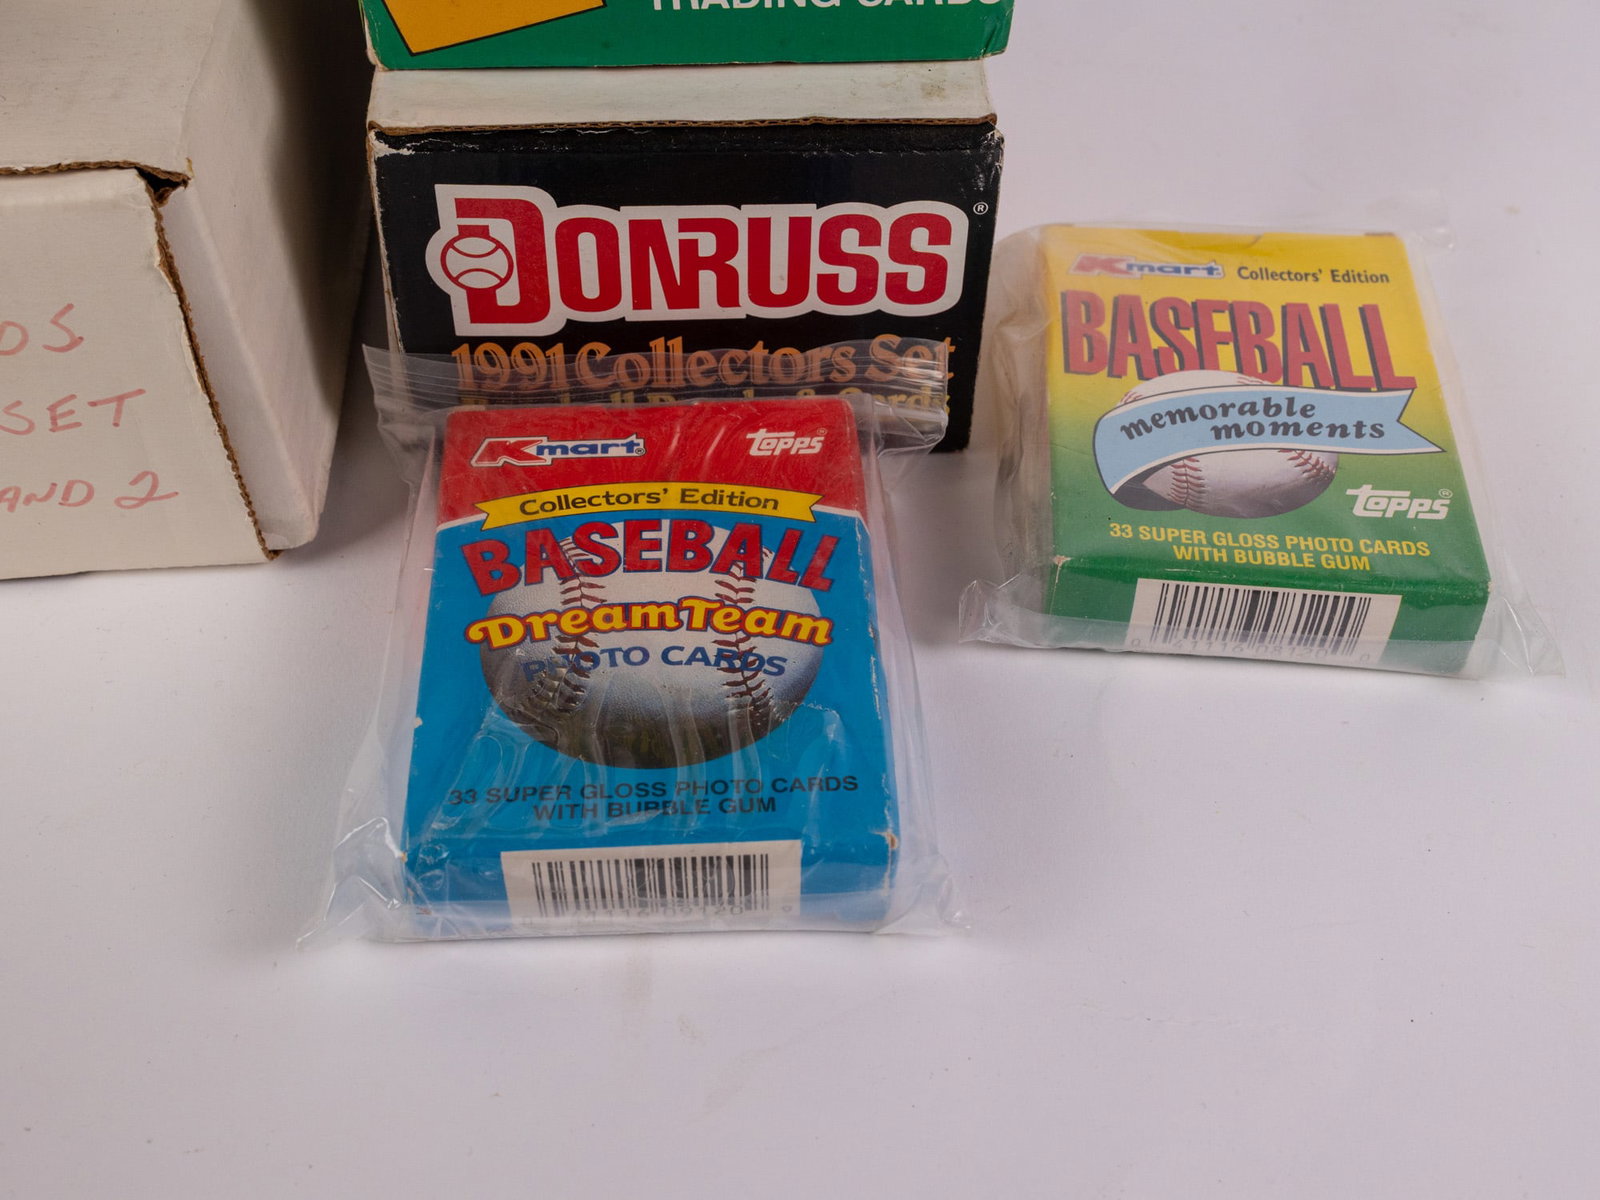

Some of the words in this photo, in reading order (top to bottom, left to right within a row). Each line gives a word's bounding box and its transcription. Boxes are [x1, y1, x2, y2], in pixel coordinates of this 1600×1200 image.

[439, 196, 953, 326] DONRUSS
[1071, 255, 1221, 277] Kmart
[1237, 266, 1322, 283] Collectors'
[1331, 269, 1390, 284] Edition
[1060, 288, 1418, 391] BASEBALL
[451, 341, 571, 391] 1991
[574, 336, 857, 390] Collectors
[866, 333, 956, 383] Set
[0, 388, 146, 436] SET
[1120, 396, 1316, 441] memorable
[1211, 418, 1385, 441] moments
[472, 435, 643, 466] Kmart
[114, 470, 179, 509] 2
[519, 487, 669, 516] Collectors'
[679, 487, 781, 511] Edition
[461, 518, 840, 596] BASEBALL
[1109, 523, 1134, 539] 33
[1139, 526, 1207, 545] SUPER
[1212, 531, 1279, 549] GLOSS
[1286, 535, 1354, 553] PHOTO
[1359, 539, 1431, 557] CARDS
[1173, 545, 1228, 563] WITH
[1234, 550, 1316, 568] BUBBLE
[1321, 554, 1371, 571] GUM
[522, 646, 650, 683] PHOTO
[660, 646, 788, 676] CARDS
[449, 788, 476, 805] 33
[486, 784, 571, 803] SUPER
[580, 781, 667, 800] GLOSS
[676, 778, 762, 796] PHOTO
[771, 775, 859, 794] CARDS
[532, 802, 598, 821] WITH
[607, 797, 711, 819] BUBBLE
[718, 796, 777, 814] GUM
